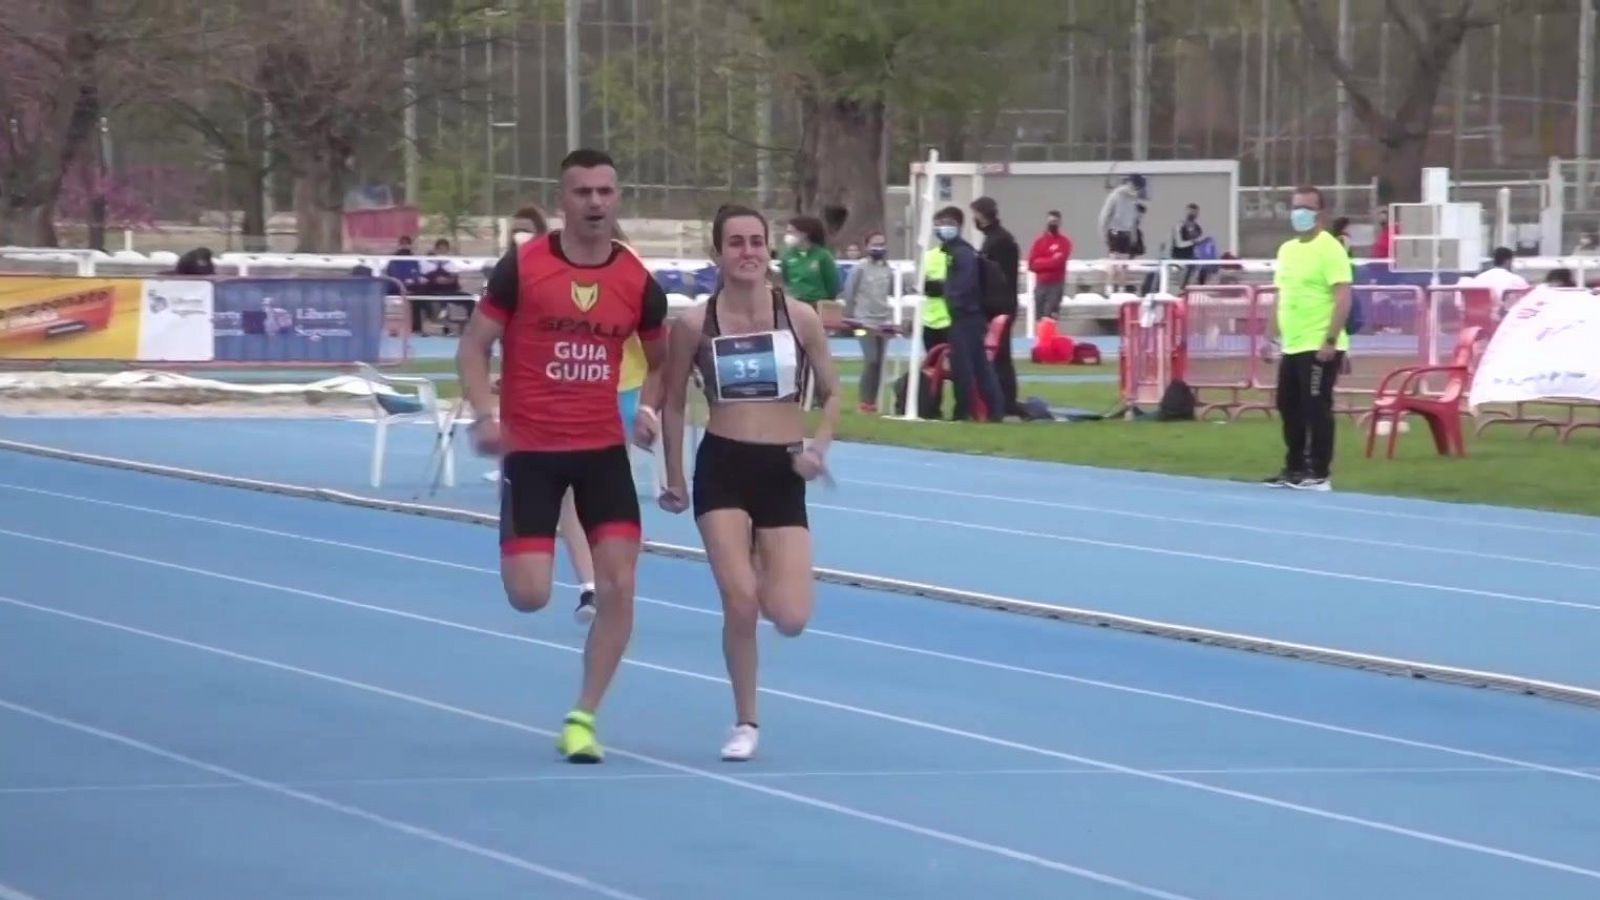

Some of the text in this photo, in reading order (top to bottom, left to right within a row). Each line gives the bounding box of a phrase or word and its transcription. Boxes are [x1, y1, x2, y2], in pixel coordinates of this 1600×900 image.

[554, 341, 608, 361] GUIA
[546, 361, 613, 382] GUIDE
[734, 359, 760, 379] 35
